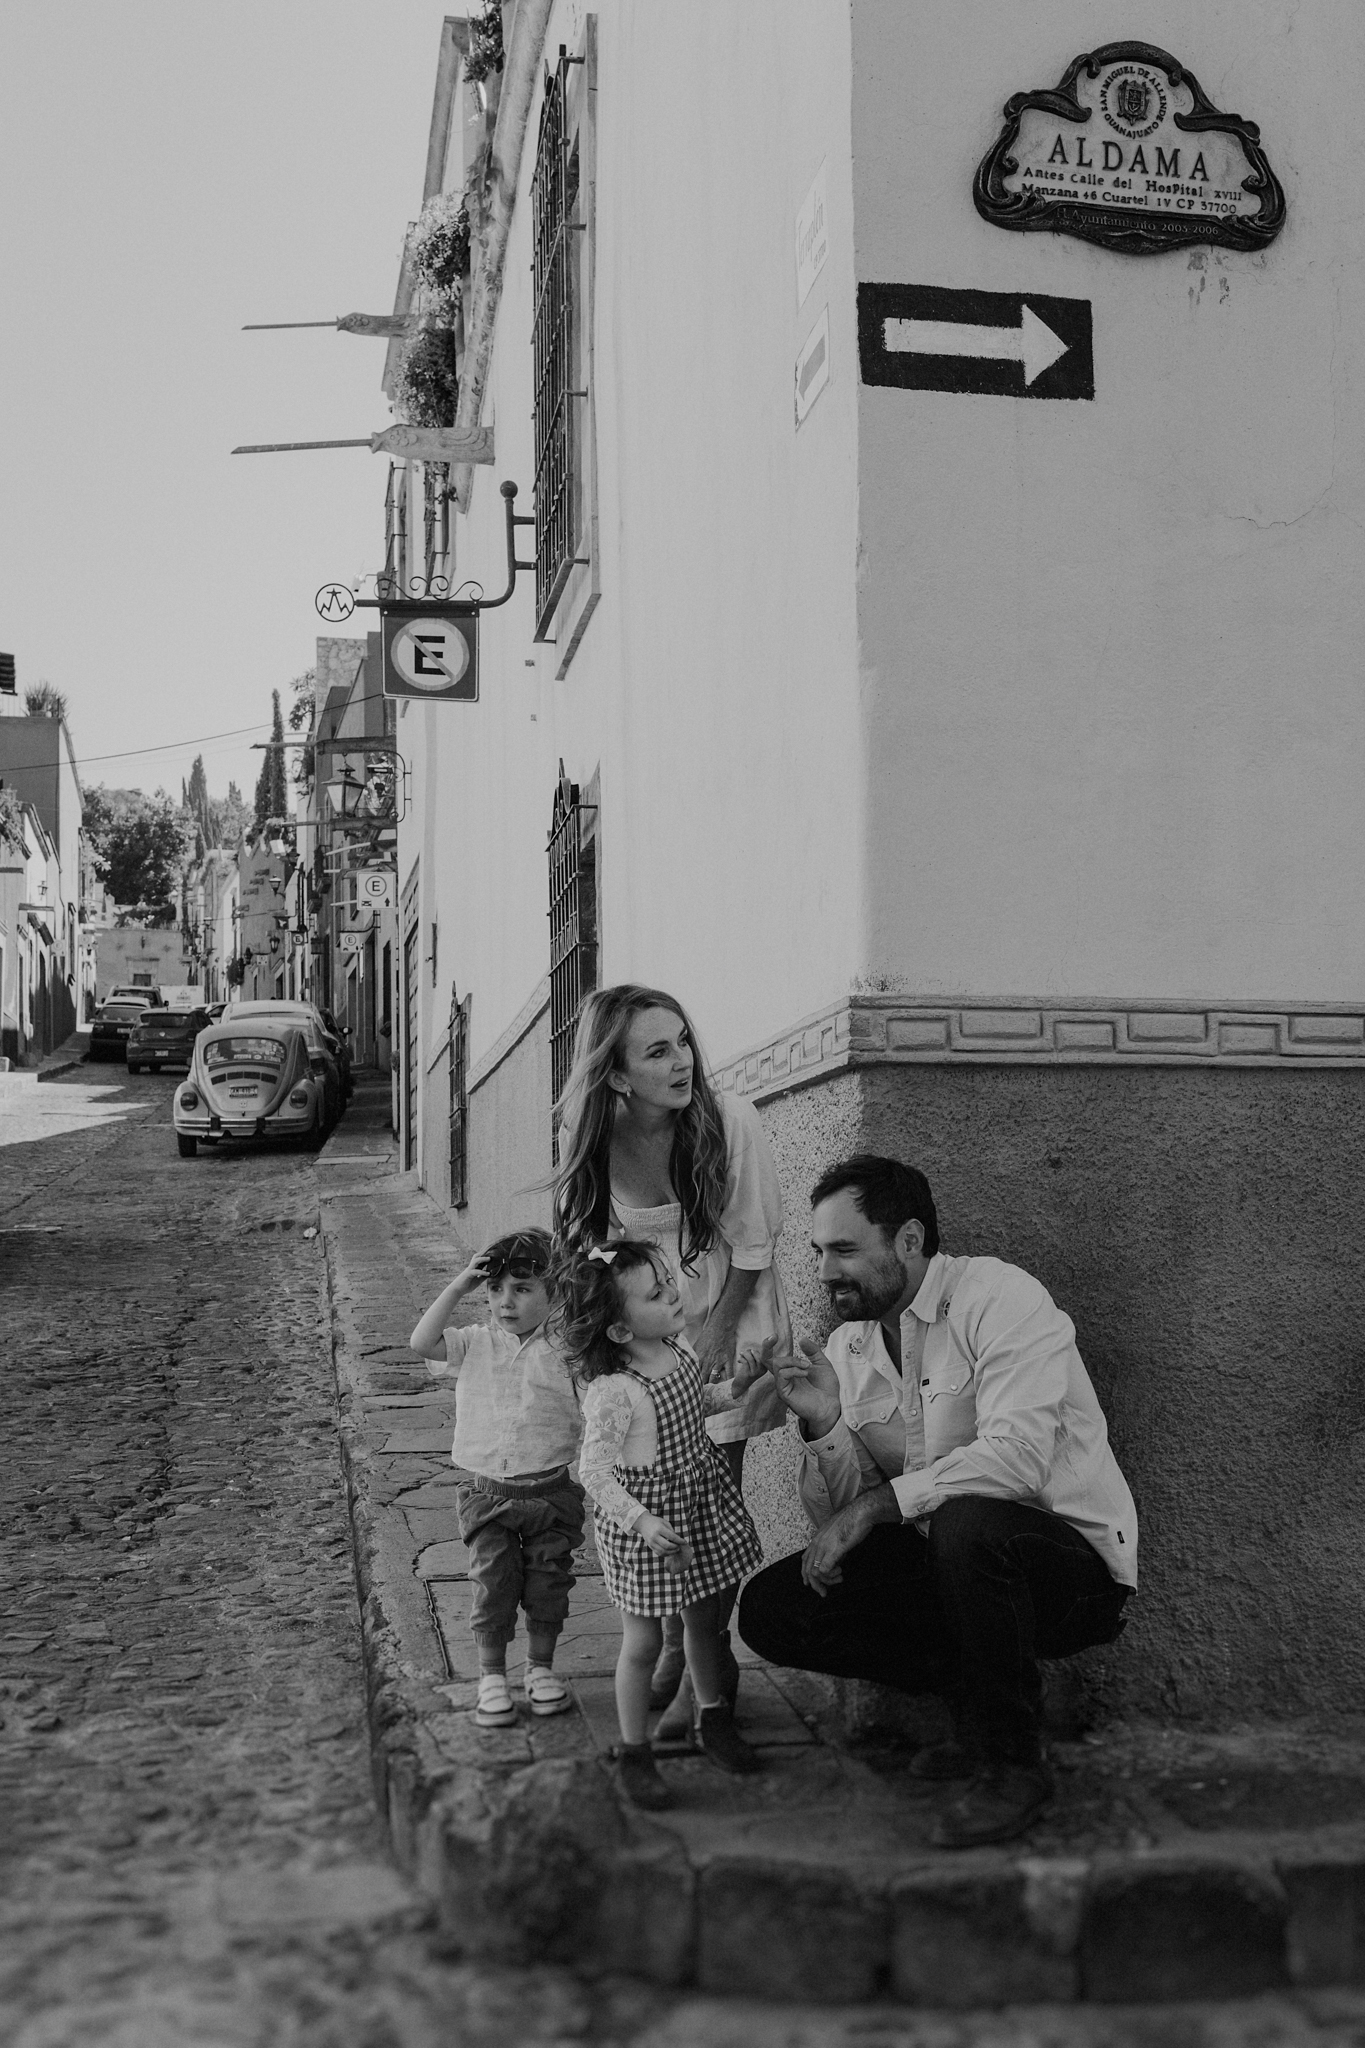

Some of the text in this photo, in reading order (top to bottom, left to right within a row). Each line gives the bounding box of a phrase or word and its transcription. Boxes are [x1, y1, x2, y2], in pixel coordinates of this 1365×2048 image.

[1100, 66, 1167, 123] SAN MIGUEL DE ALLENDE
[1104, 113, 1159, 140] GUANAJUATO
[1047, 133, 1210, 182] ALDAMA
[1023, 167, 1064, 181] Antes
[1113, 177, 1132, 189] del
[1022, 183, 1079, 199] Manzana
[1083, 190, 1098, 200] 46
[1102, 191, 1148, 206] Cuartel
[1176, 198, 1195, 210] CP
[1200, 201, 1237, 214] 37700
[414, 635, 446, 675] E
[372, 880, 381, 892] E
